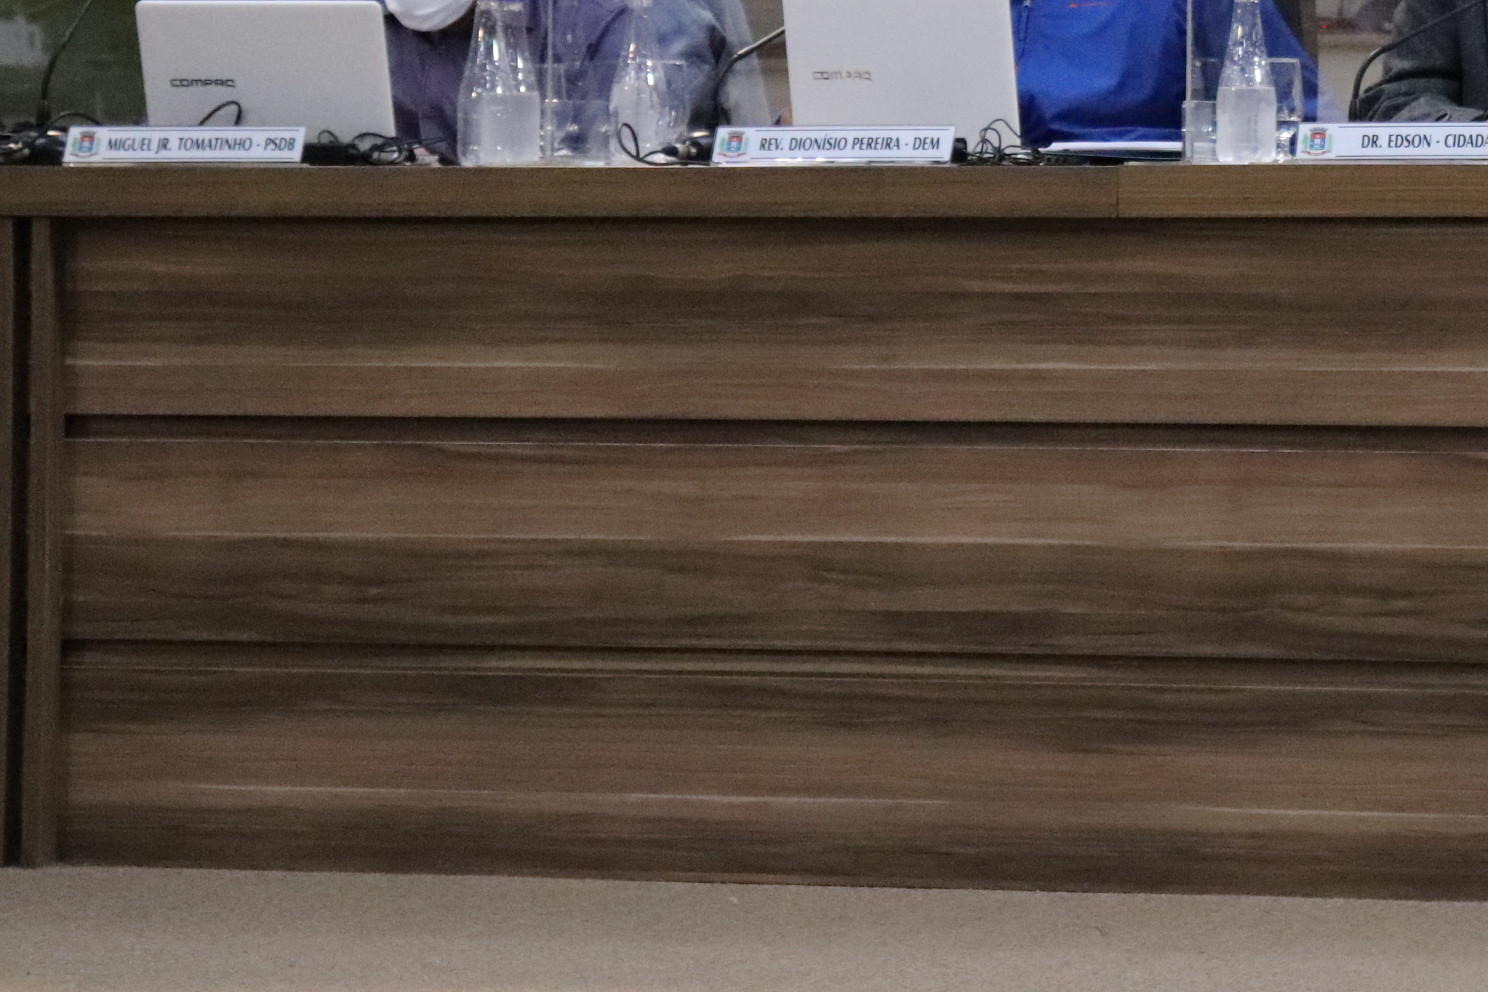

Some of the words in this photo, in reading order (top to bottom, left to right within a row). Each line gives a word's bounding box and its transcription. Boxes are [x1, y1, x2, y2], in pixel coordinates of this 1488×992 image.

[170, 78, 236, 88] COMPAQ
[105, 137, 153, 151] MIGUEL
[155, 137, 172, 154] JR.
[177, 137, 253, 151] TOMATINHO
[264, 137, 296, 151] PSDB
[759, 137, 783, 151] REV.
[788, 134, 847, 151] DIONÍSIO
[851, 137, 900, 150] PEREIRA
[912, 137, 940, 150] DEM
[1361, 134, 1382, 148] DR.
[1388, 134, 1431, 148] EDSON
